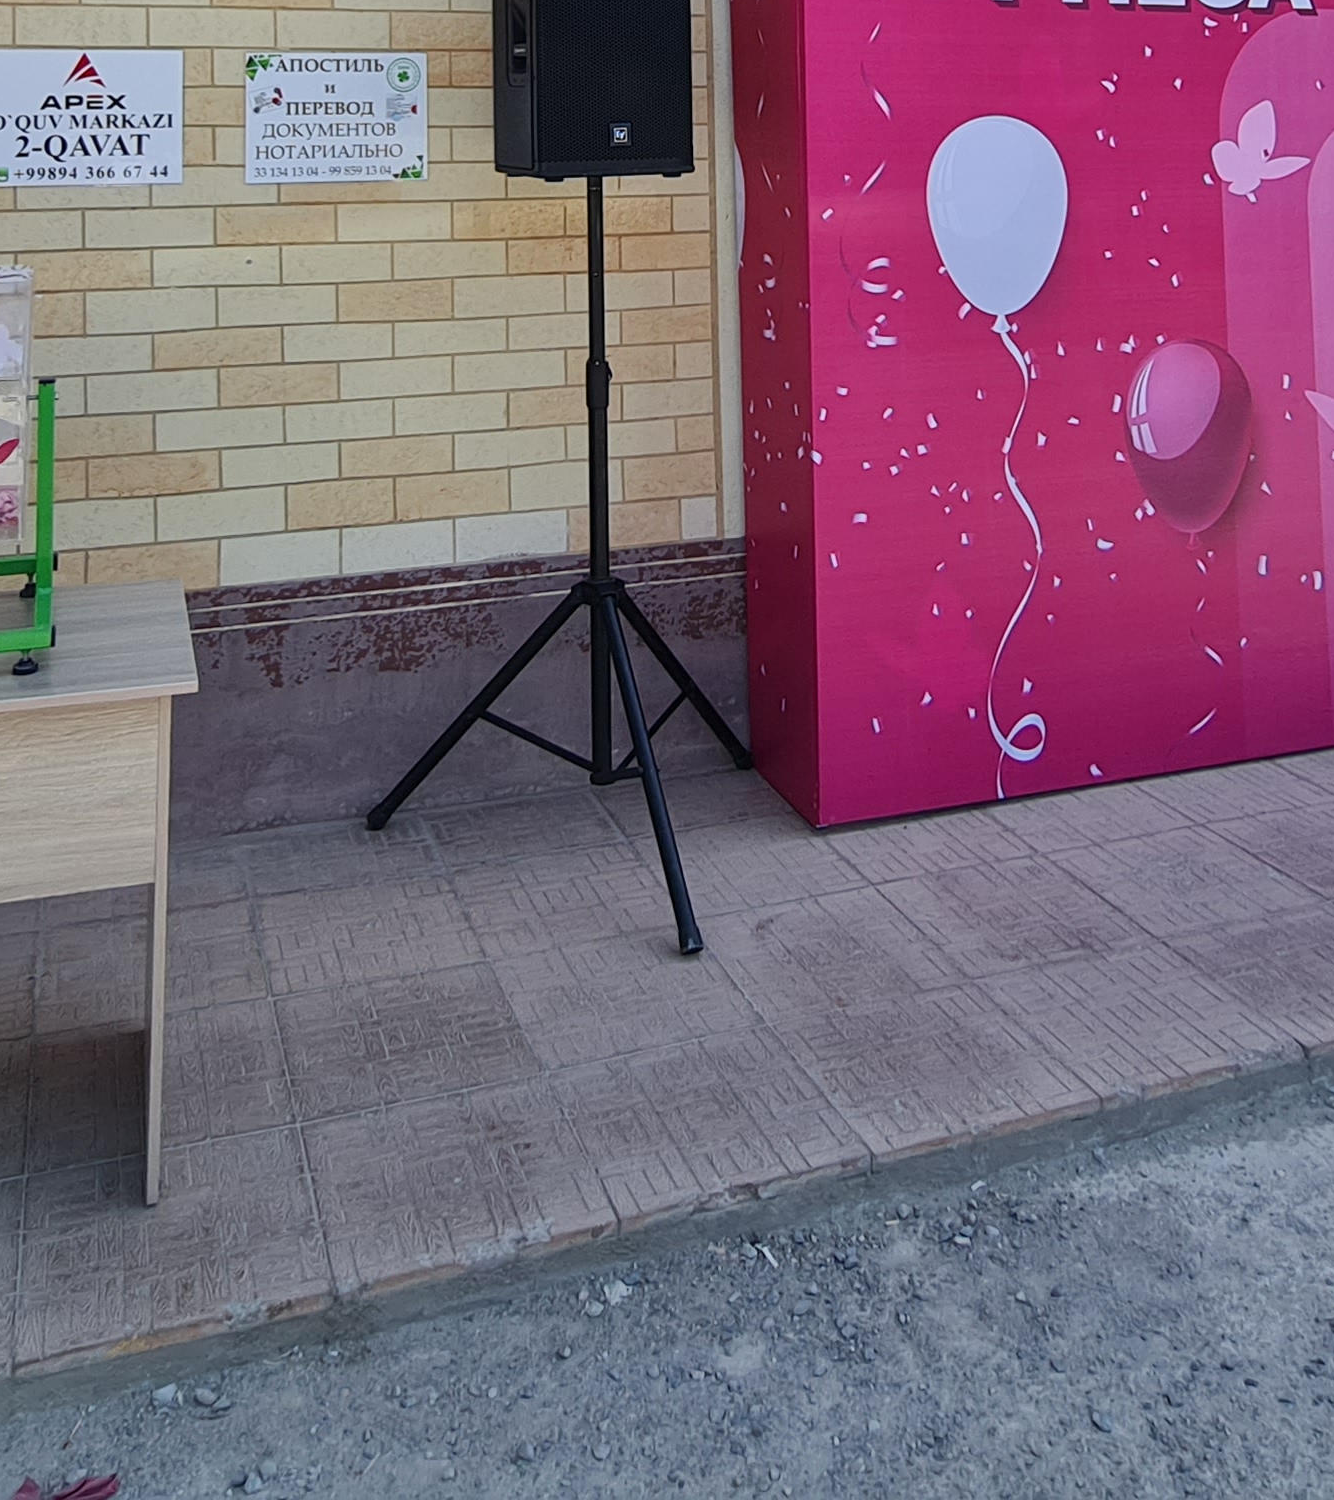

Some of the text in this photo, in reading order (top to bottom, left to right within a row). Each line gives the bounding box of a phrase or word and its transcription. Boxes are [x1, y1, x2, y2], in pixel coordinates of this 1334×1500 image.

[275, 57, 385, 74] АПОСТИЛЬ
[40, 94, 127, 111] APEX
[285, 101, 375, 118] ПЕРЕВОД
[69, 113, 174, 130] MARKAZI
[261, 121, 397, 141] ДОКУМЕНТОВ
[14, 133, 151, 163] 2-QAVAT
[254, 143, 404, 161] НОТАРИАЛЬНО
[13, 164, 169, 181] +99894 366 67 44
[254, 167, 267, 178] 33
[270, 166, 290, 178] 134
[292, 167, 305, 178] 13
[306, 166, 319, 178] 04
[329, 166, 342, 177] 99
[366, 165, 378, 177] 13
[379, 164, 393, 176] 04
